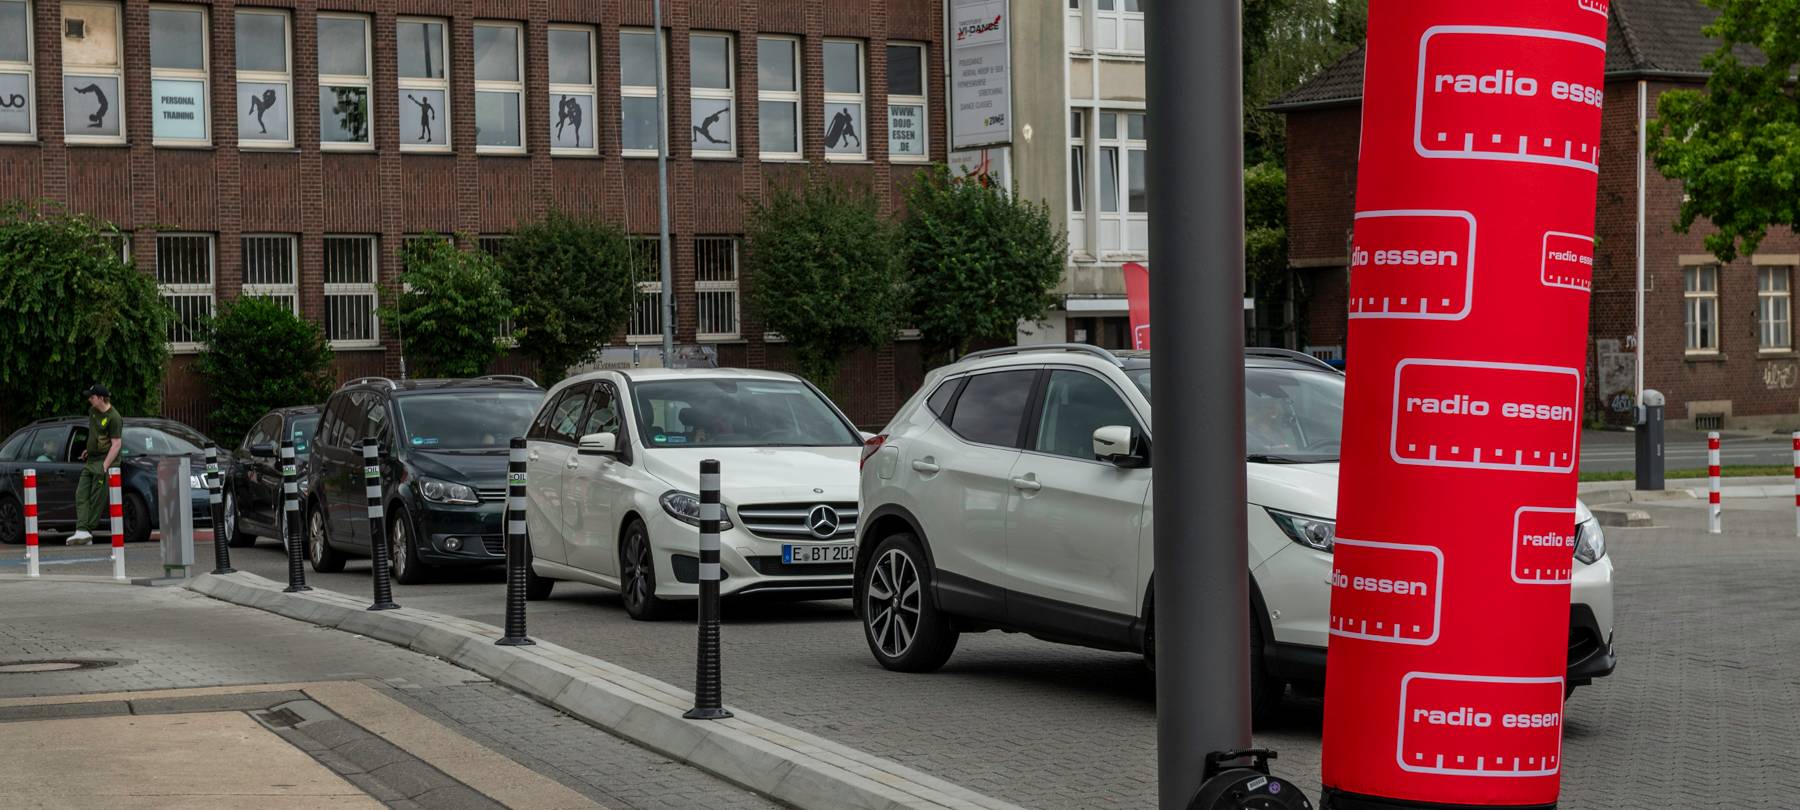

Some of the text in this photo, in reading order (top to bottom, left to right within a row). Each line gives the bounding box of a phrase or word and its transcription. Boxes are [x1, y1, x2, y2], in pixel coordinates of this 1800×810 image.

[1434, 69, 1603, 108] radio esse
[161, 96, 195, 105] PERSONAL
[163, 111, 194, 120] TRAINING
[893, 118, 915, 128] DOJO-
[893, 130, 915, 140] ESSEN
[899, 142, 910, 152] .DE
[1352, 246, 1458, 267] dio essen
[1548, 250, 1577, 262] radio
[1406, 394, 1573, 422] radio essen
[1522, 532, 1563, 546] radio
[793, 547, 802, 561] E
[812, 547, 830, 561] BT
[1332, 568, 1427, 596] dio essen
[1413, 707, 1559, 728] radio essen
